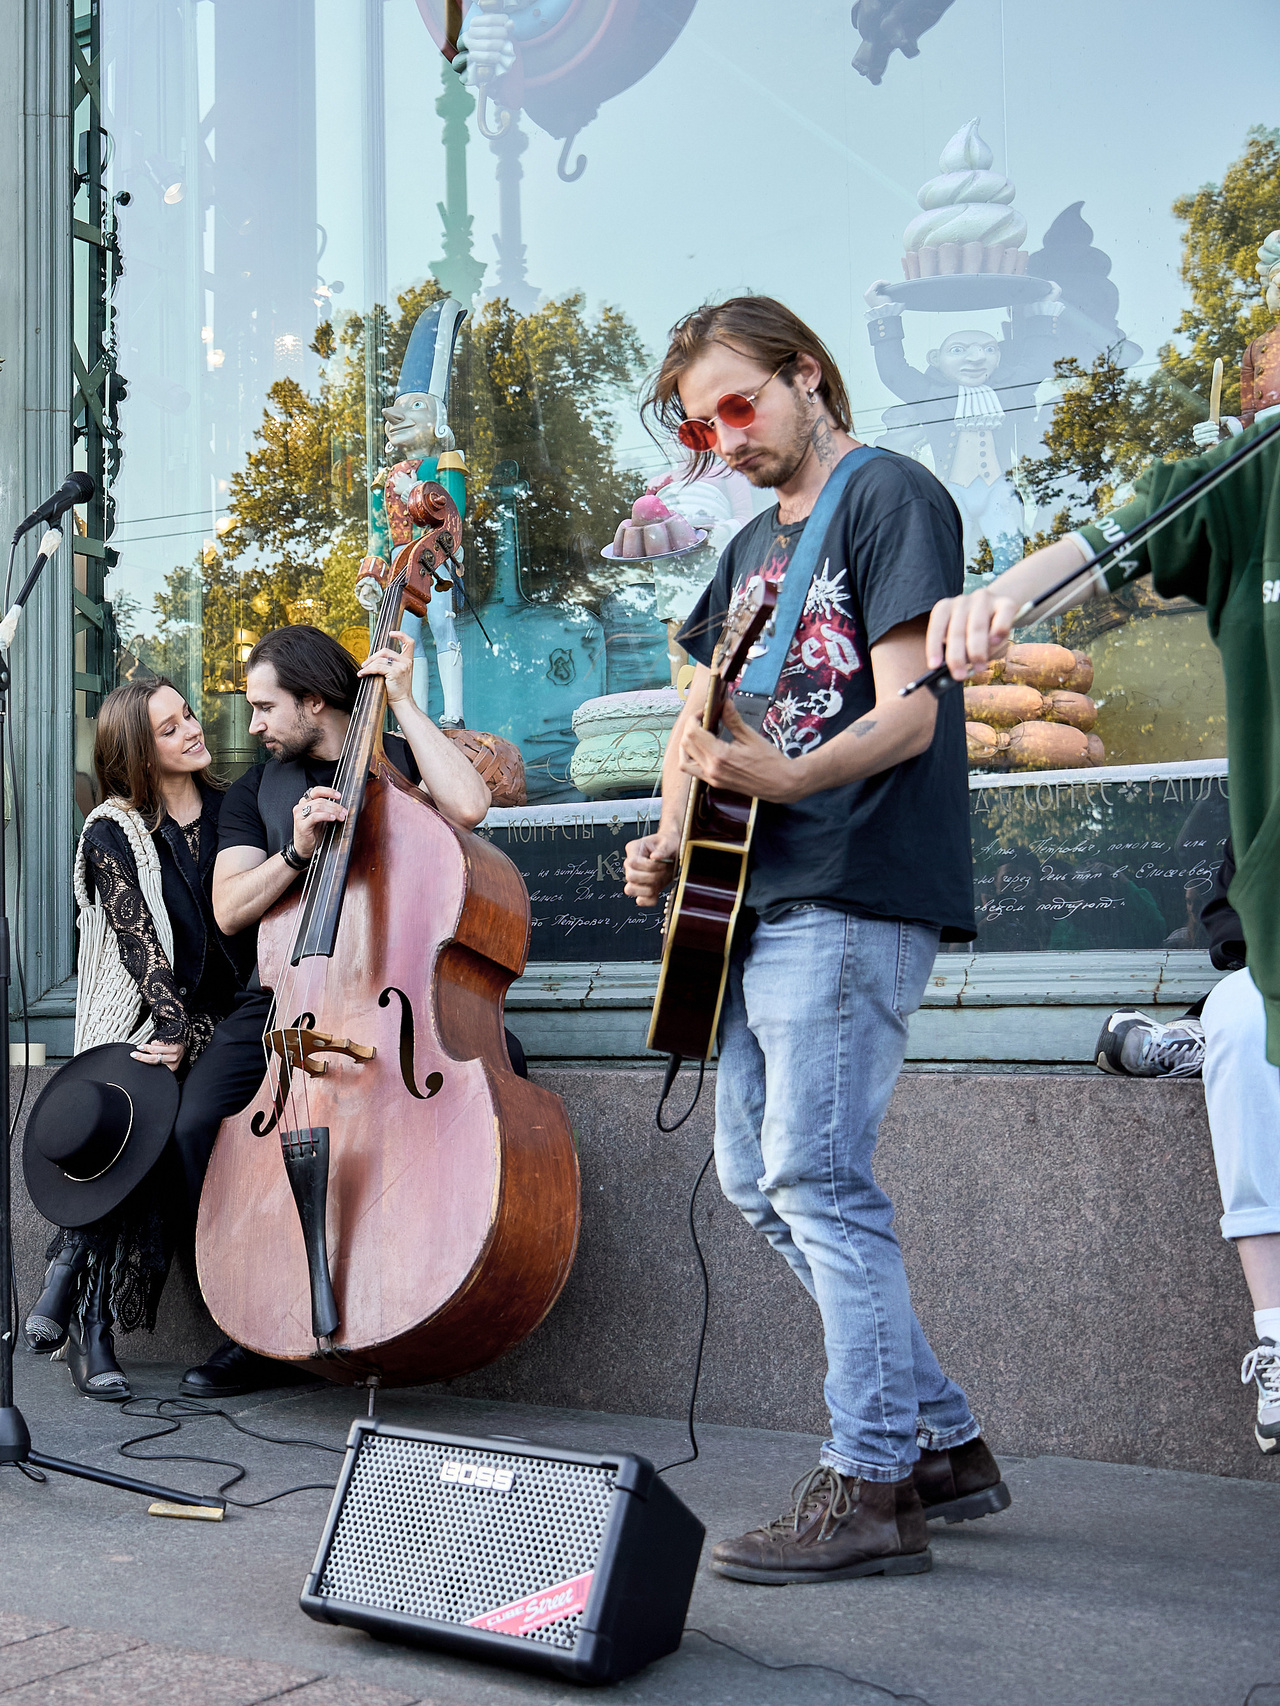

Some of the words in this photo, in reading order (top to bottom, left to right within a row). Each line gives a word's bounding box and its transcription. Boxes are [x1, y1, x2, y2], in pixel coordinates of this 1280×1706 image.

[1022, 778, 1114, 811] COFFEE
[1148, 775, 1230, 804] PATISSE
[507, 814, 595, 843] КОНФЕТЫ
[440, 1460, 515, 1492] BOSS
[486, 1604, 525, 1627] CUBE
[523, 1587, 575, 1622] Street
